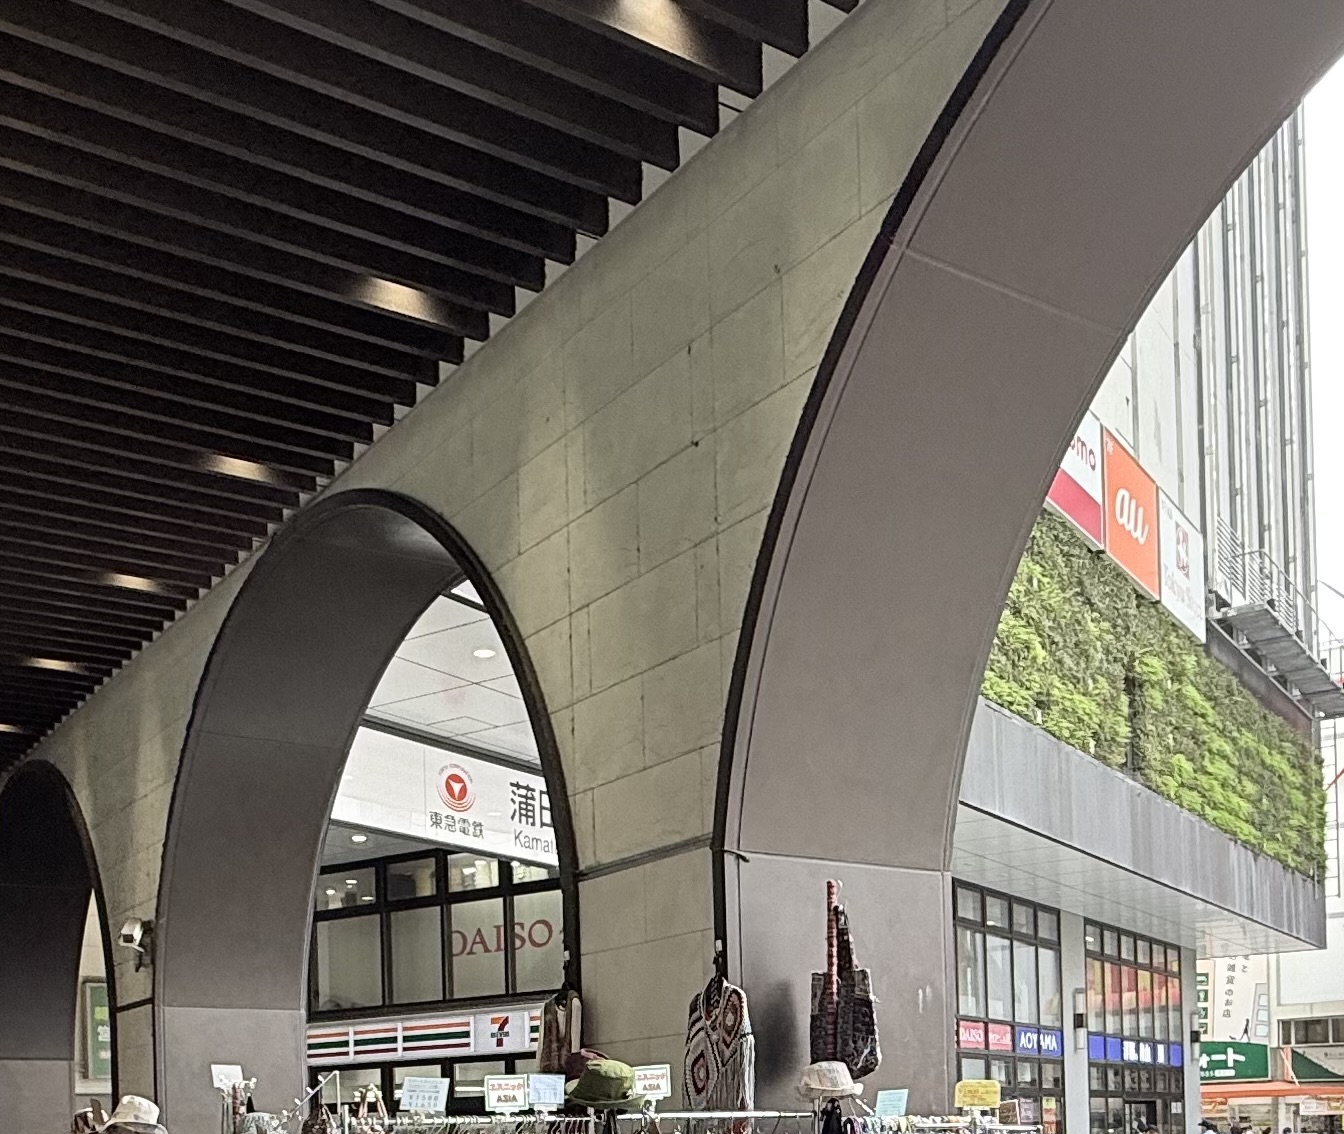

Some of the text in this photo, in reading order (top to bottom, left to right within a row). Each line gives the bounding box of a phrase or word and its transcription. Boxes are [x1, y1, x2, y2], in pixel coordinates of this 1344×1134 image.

[1115, 488, 1149, 545] au
[429, 811, 484, 839] 東急電鉄
[514, 828, 558, 855] Kamat
[452, 919, 554, 957] DAISO
[1019, 1031, 1058, 1051] AOYAMA
[496, 1094, 519, 1103] ASIA
